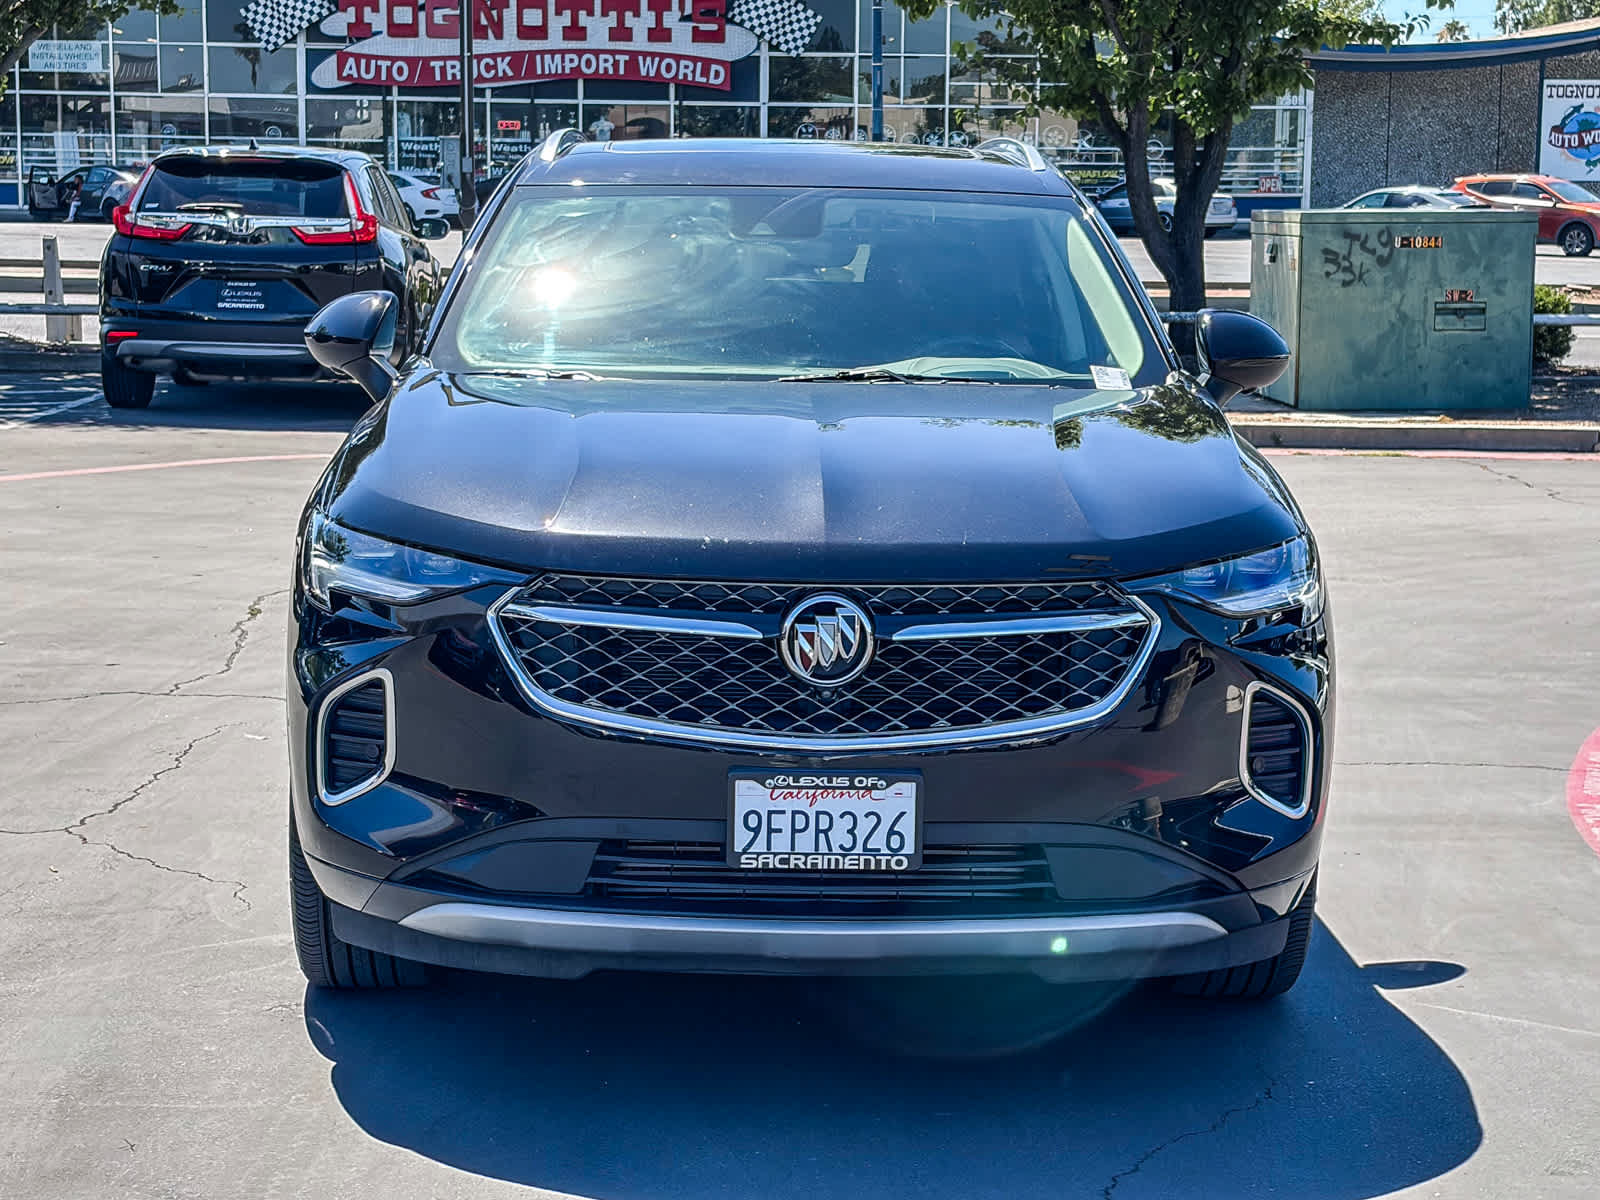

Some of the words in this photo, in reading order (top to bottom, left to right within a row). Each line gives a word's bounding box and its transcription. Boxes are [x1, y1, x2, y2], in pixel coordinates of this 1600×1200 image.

[338, 0, 726, 43] TOGNOTTI'S
[342, 57, 409, 81] AUTO
[536, 53, 629, 76] IMPORT
[638, 55, 726, 86] WORLD
[1550, 132, 1579, 148] AUTO
[1260, 177, 1282, 192] OPEN
[1394, 236, 1442, 249] U-10844
[1446, 290, 1473, 302] SW-2
[789, 776, 850, 788] LEXUS
[854, 777, 879, 788] OF
[769, 788, 886, 808] California
[741, 809, 908, 853] 9FPR326
[740, 854, 909, 870] SACRAMENTO
